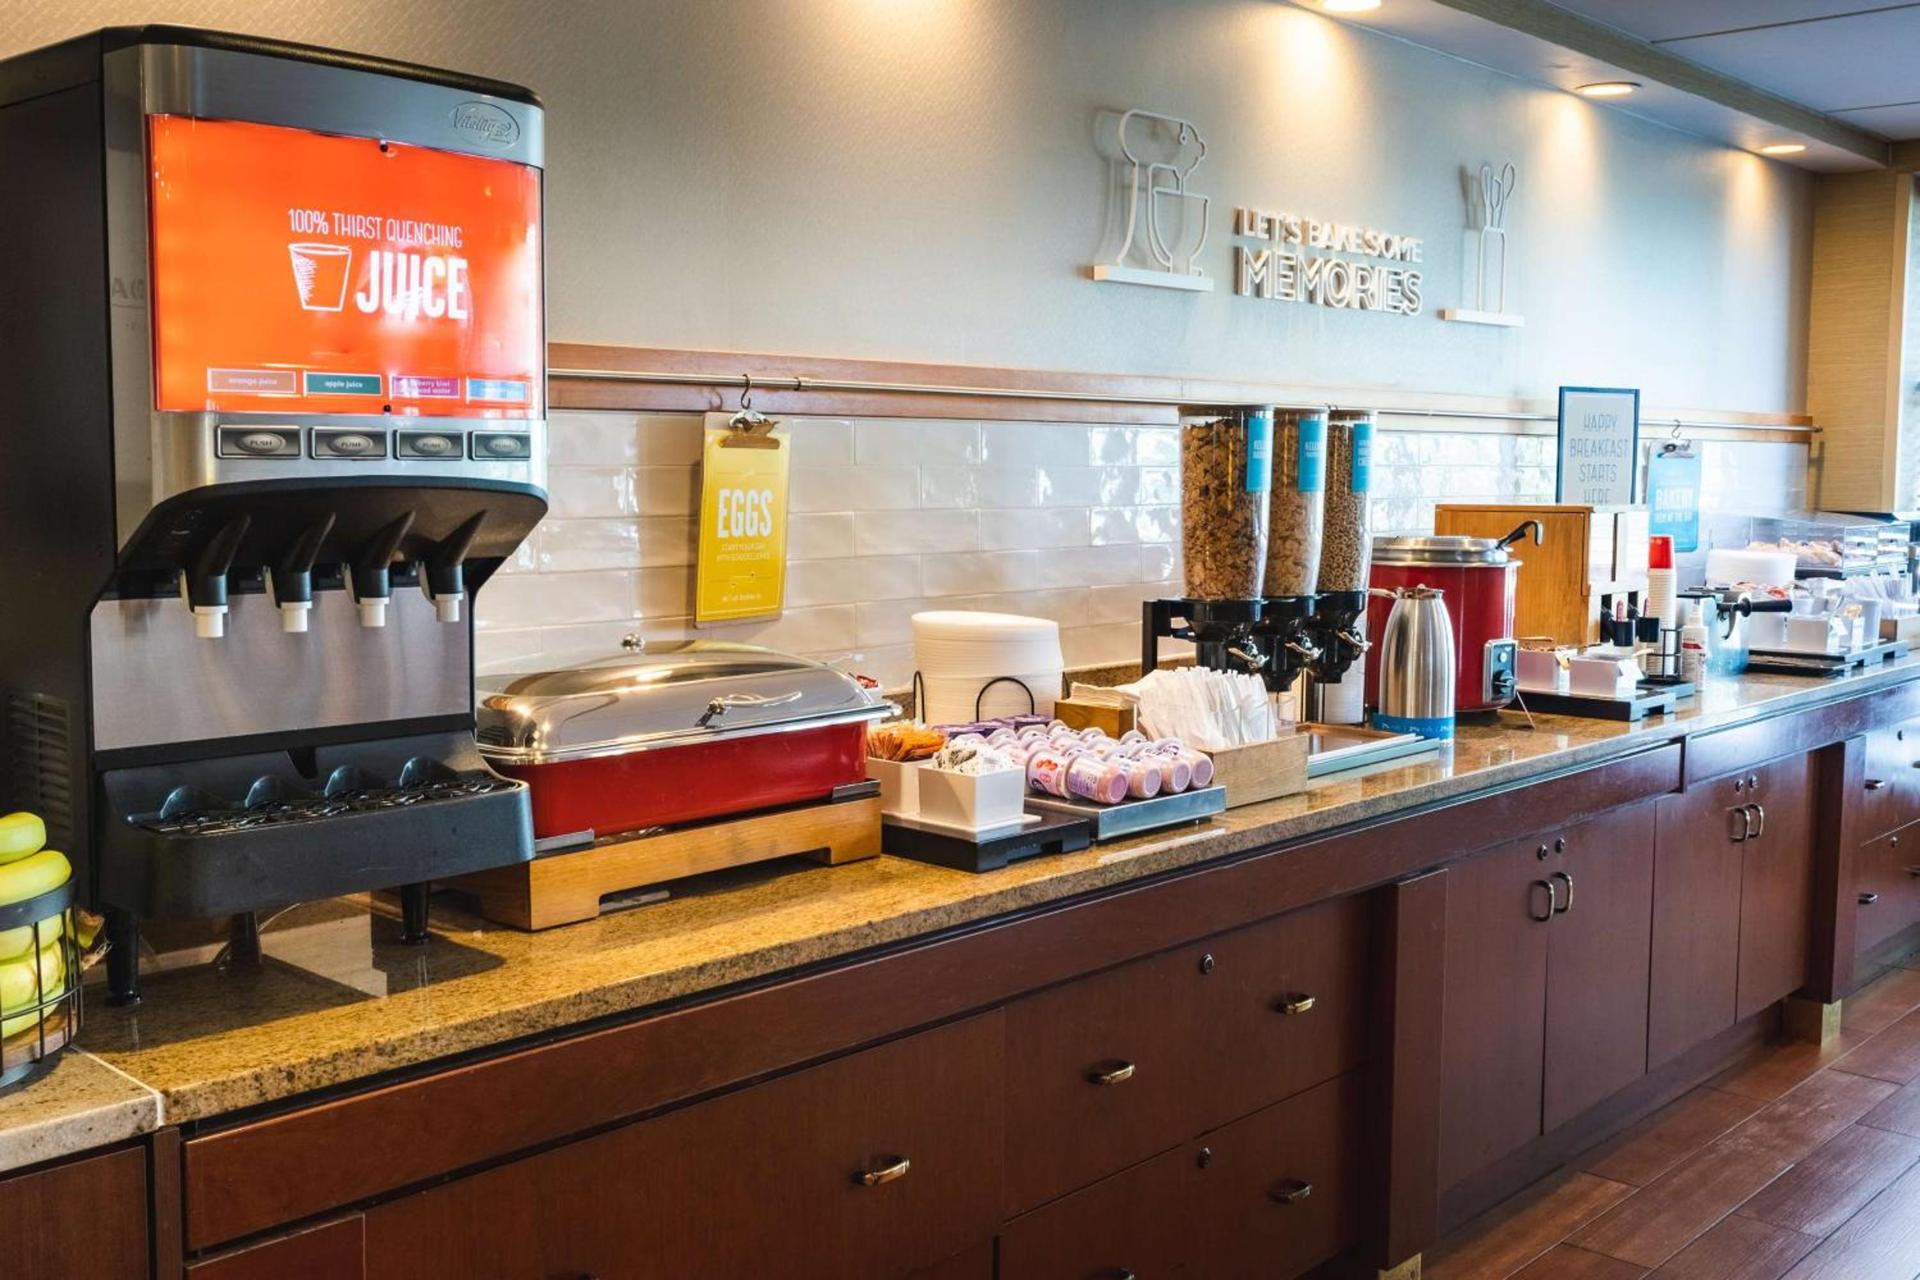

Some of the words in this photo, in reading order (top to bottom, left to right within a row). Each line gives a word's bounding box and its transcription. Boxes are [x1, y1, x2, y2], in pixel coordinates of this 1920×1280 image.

[288, 208, 329, 235] 100%
[332, 212, 382, 240] THIRST
[386, 218, 463, 249] QUENCHING
[1235, 207, 1302, 246] LET'S
[1307, 217, 1364, 253] BAKE
[1364, 230, 1424, 263] SOME
[356, 249, 468, 320] JUICE
[1235, 246, 1423, 317] MEMORIES
[324, 380, 345, 389] apple
[345, 380, 363, 389] juice
[1583, 413, 1618, 432] HAPPY
[250, 439, 273, 447] PUSH
[1569, 438, 1629, 458] BREAKFAST
[1578, 464, 1617, 483] STARTS
[717, 488, 774, 539] EGGS
